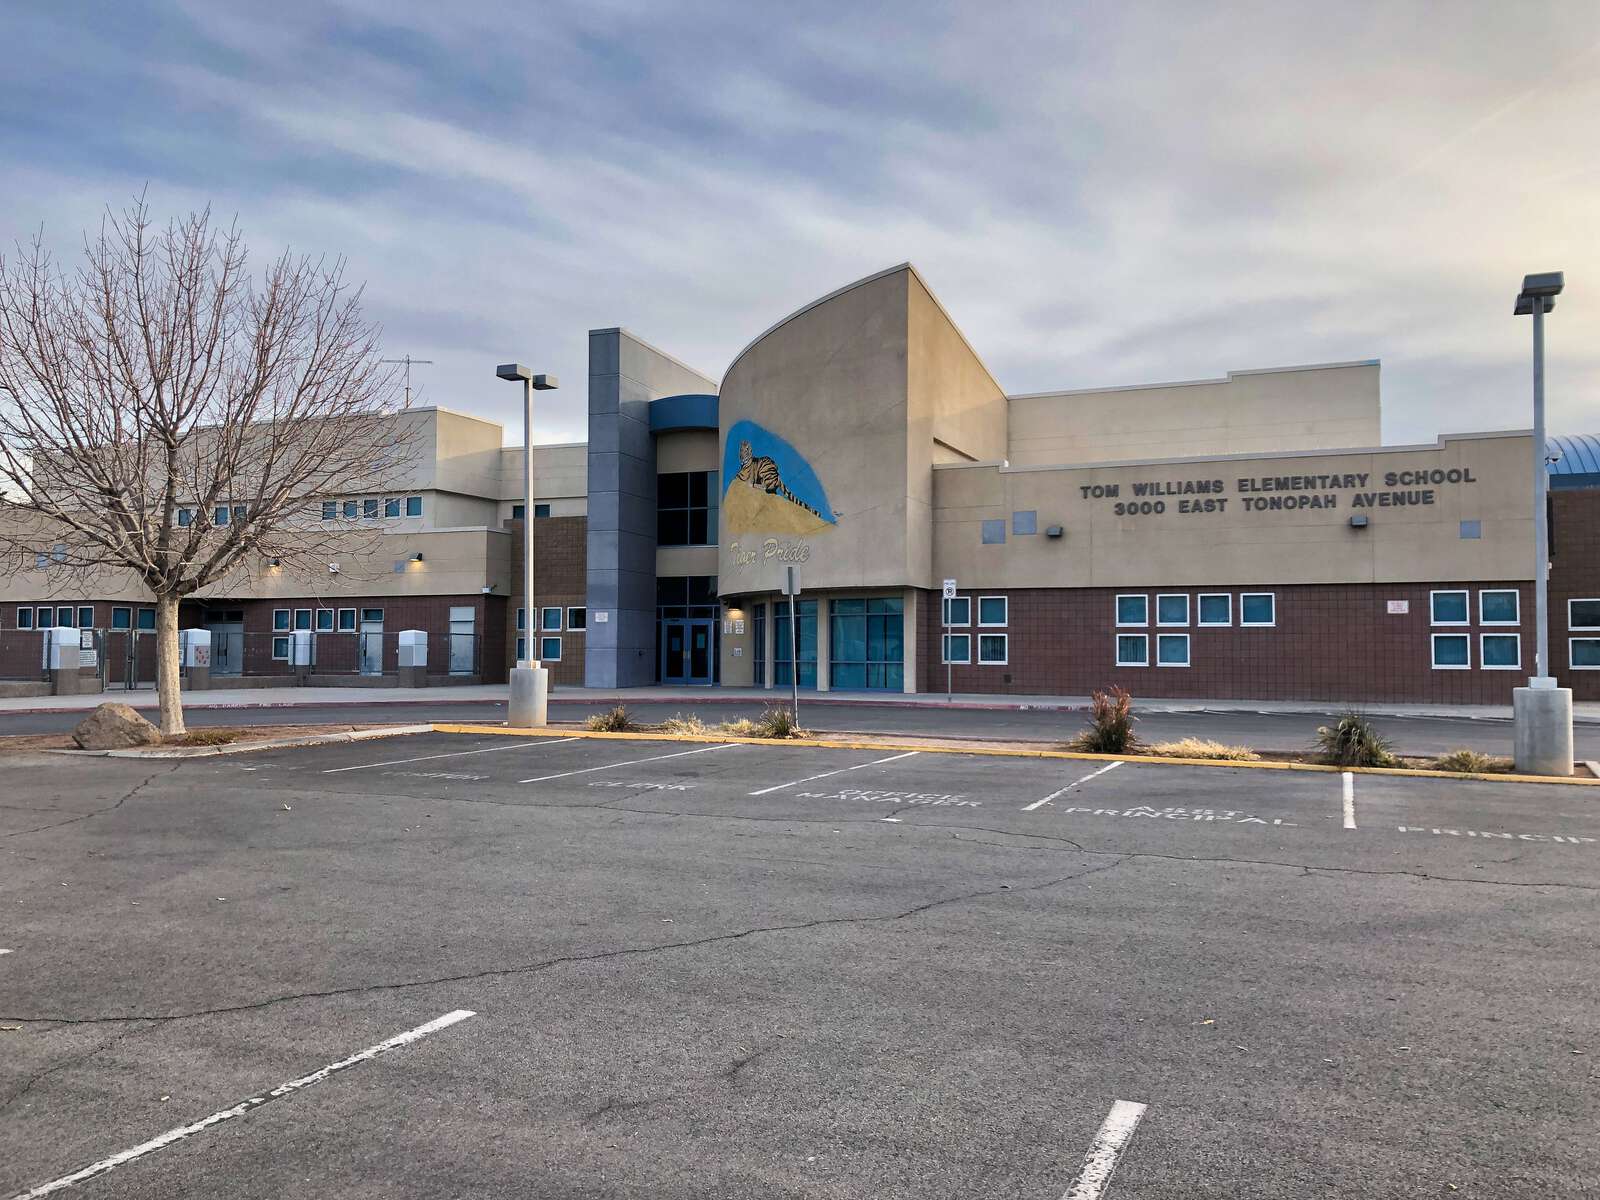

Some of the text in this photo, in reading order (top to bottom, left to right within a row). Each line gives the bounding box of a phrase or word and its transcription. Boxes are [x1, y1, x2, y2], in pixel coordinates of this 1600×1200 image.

[1080, 468, 1477, 500] TOM WILLIAMS ELEMENTARY SCHOOL
[1114, 490, 1434, 516] 3000 EAST TONOPAH AVENUE
[763, 537, 809, 565] Pride
[587, 781, 695, 791] CLERK
[795, 792, 983, 807] MANAGER
[839, 789, 967, 803] OFFICE
[1065, 808, 1298, 826] PRINCIPAL
